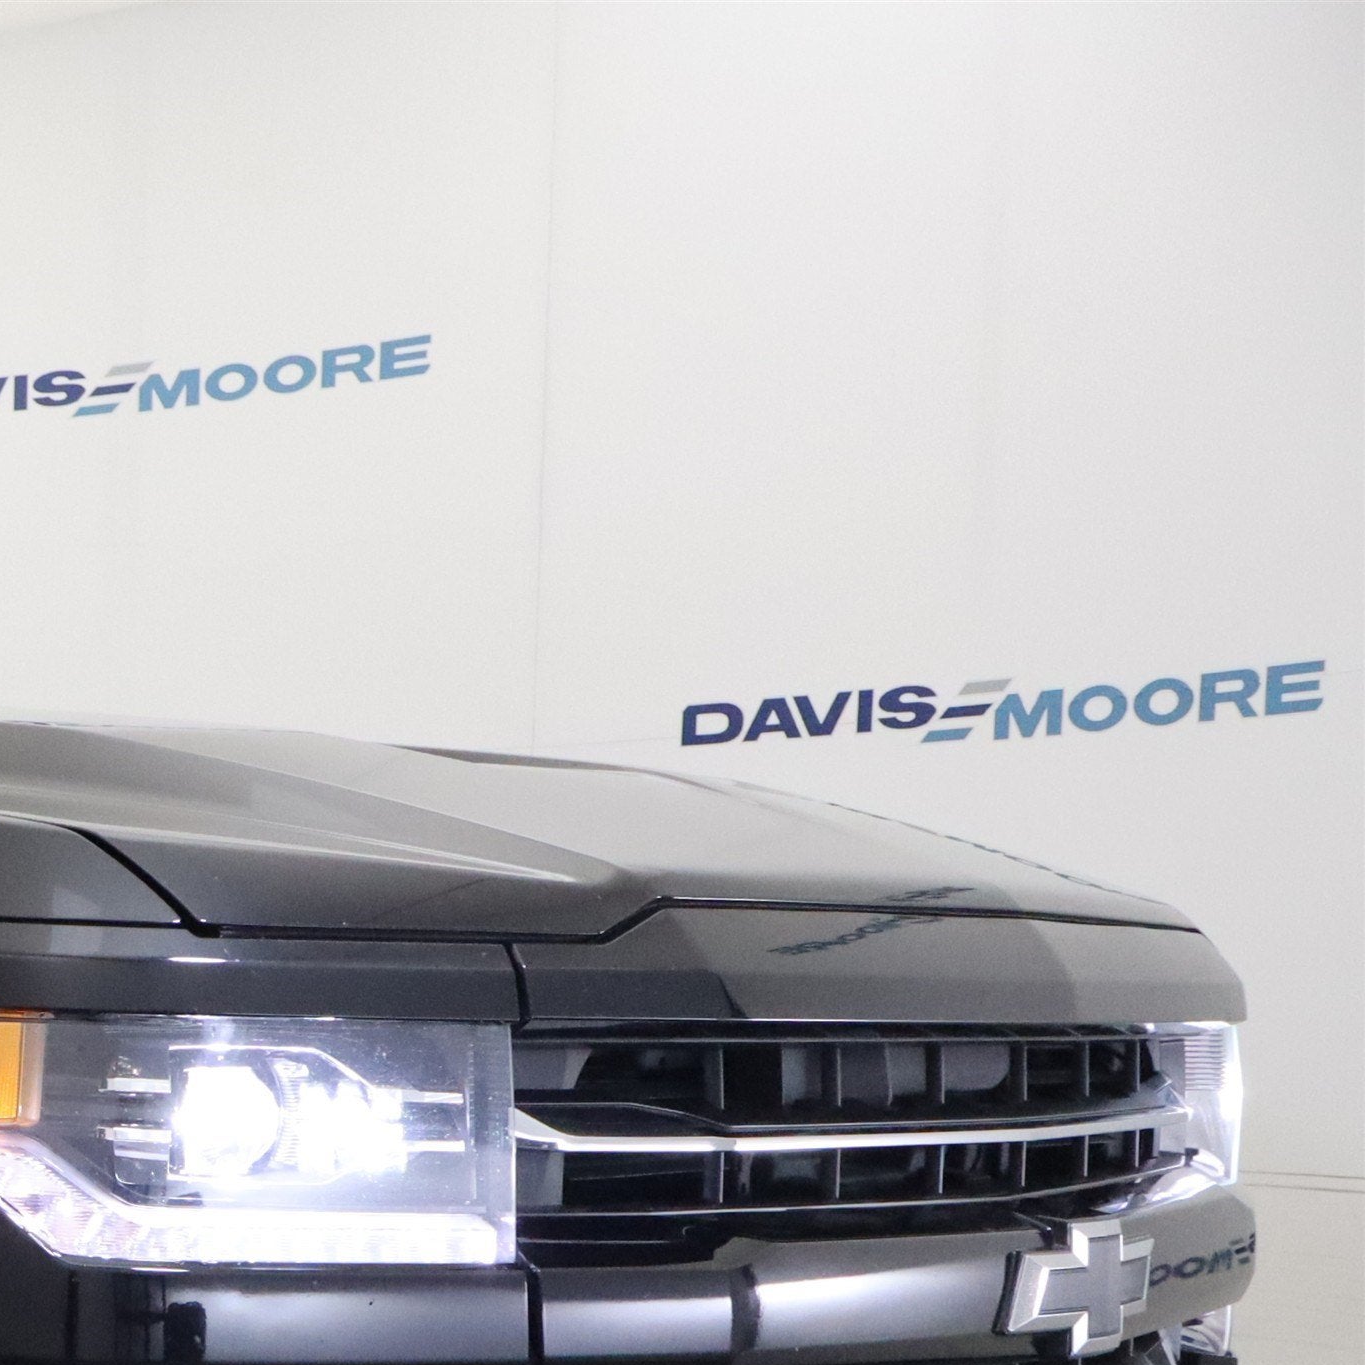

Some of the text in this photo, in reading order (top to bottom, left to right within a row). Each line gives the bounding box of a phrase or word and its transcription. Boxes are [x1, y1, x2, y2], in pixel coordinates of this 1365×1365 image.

[137, 334, 432, 413] MOORE
[680, 659, 1326, 747] DAVIS MOORE
